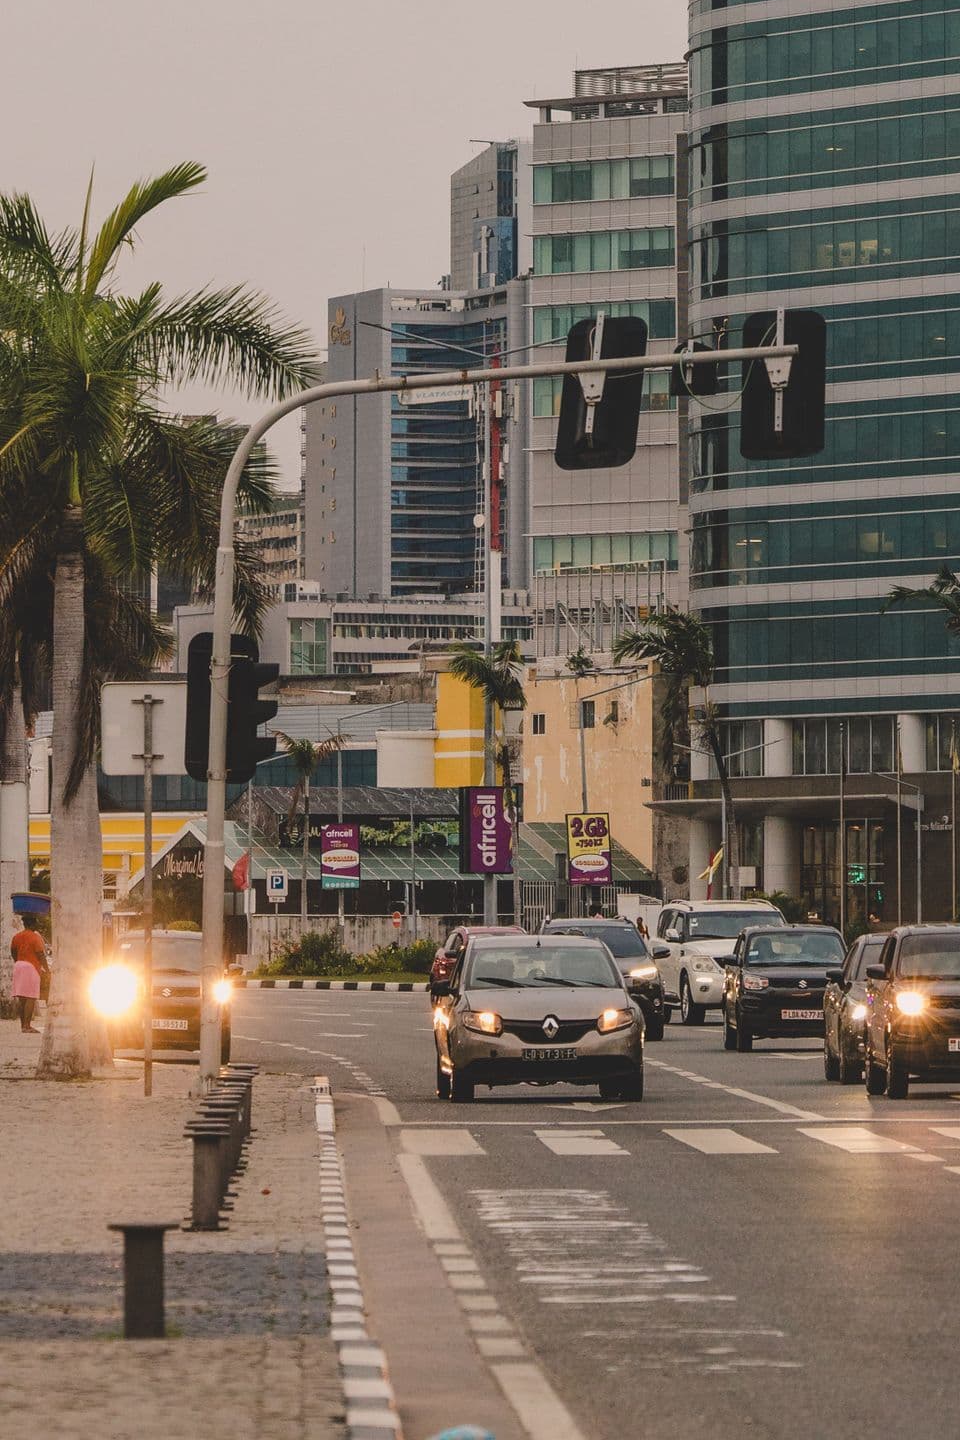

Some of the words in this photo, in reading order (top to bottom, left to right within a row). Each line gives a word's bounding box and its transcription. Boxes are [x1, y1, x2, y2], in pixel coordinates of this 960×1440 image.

[325, 828, 353, 838] africell
[476, 794, 497, 867] africell
[570, 817, 584, 838] 2
[584, 817, 608, 838] GB
[272, 876, 282, 888] P
